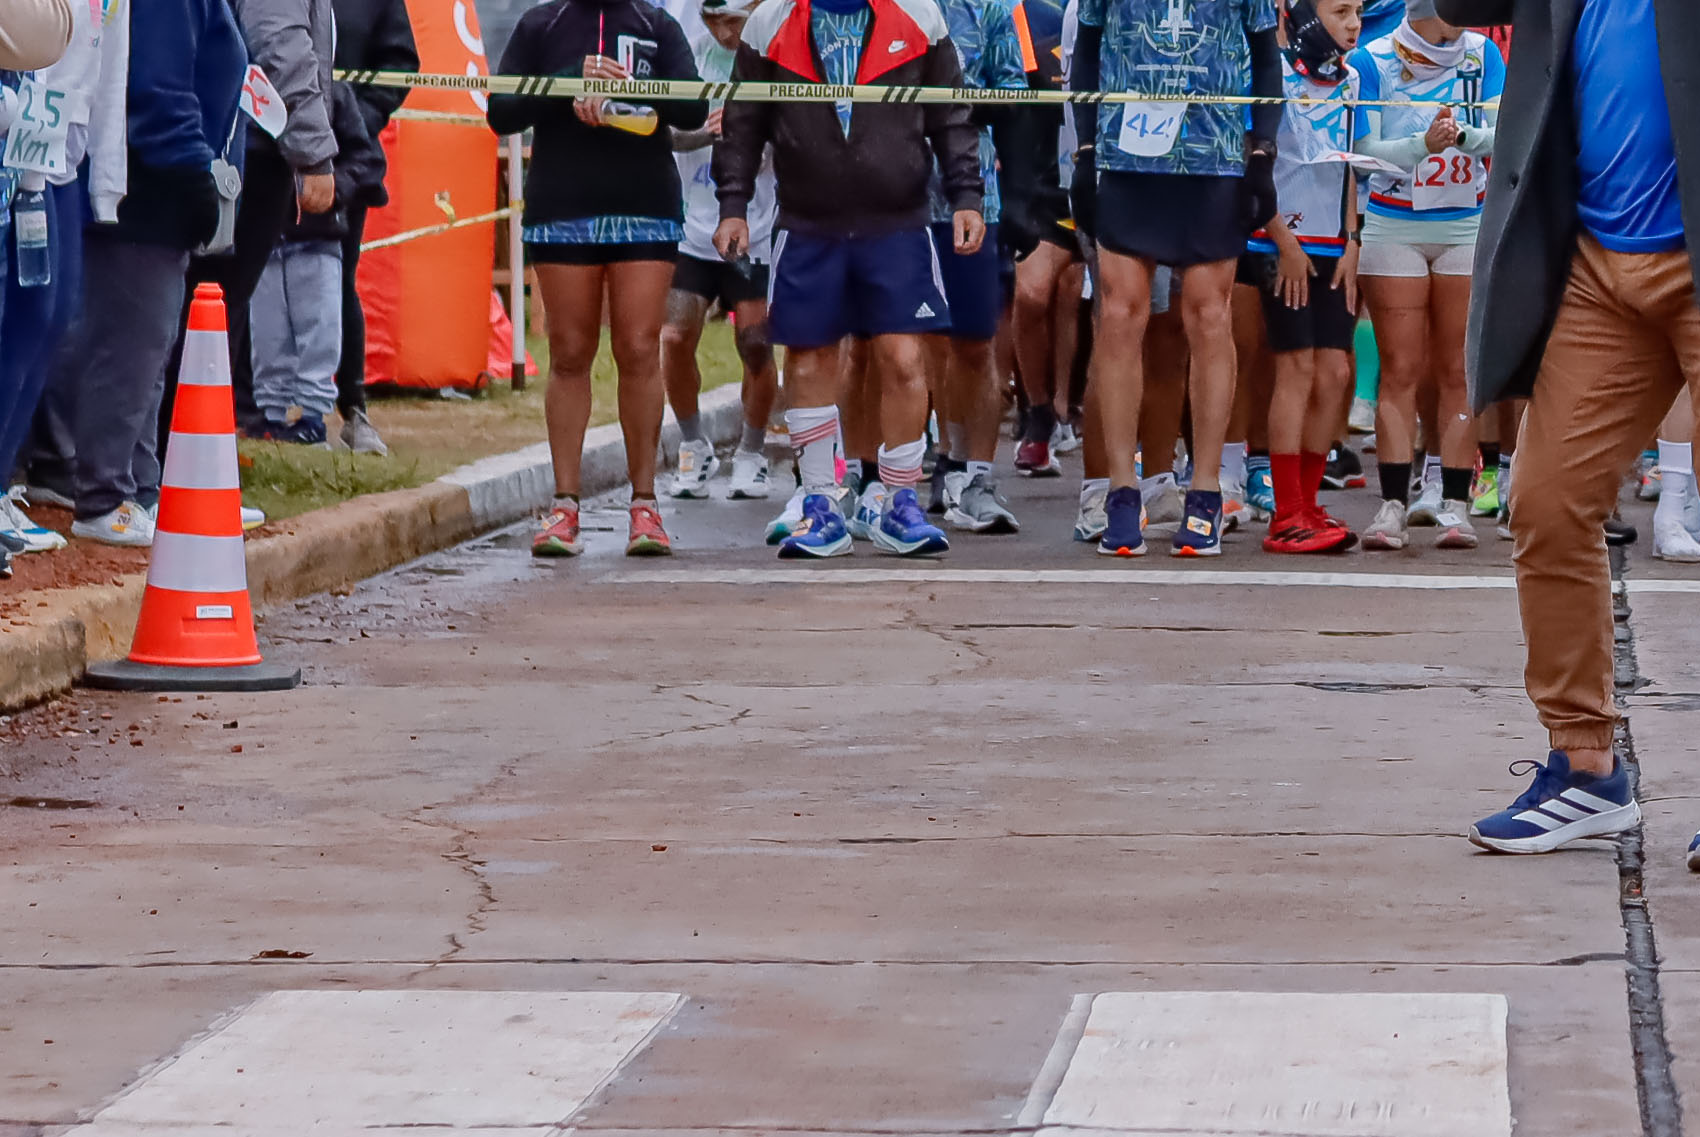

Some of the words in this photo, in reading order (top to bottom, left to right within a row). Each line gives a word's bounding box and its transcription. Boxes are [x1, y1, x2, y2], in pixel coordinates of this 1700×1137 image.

[404, 75, 488, 90] PRECAUCION
[583, 80, 671, 95] PRECAUCION
[769, 84, 855, 98] PRECAUCION
[952, 88, 1039, 100] PRECAUCION
[21, 88, 66, 134] 2,5
[9, 127, 55, 168] Km.
[1413, 154, 1473, 188] 128
